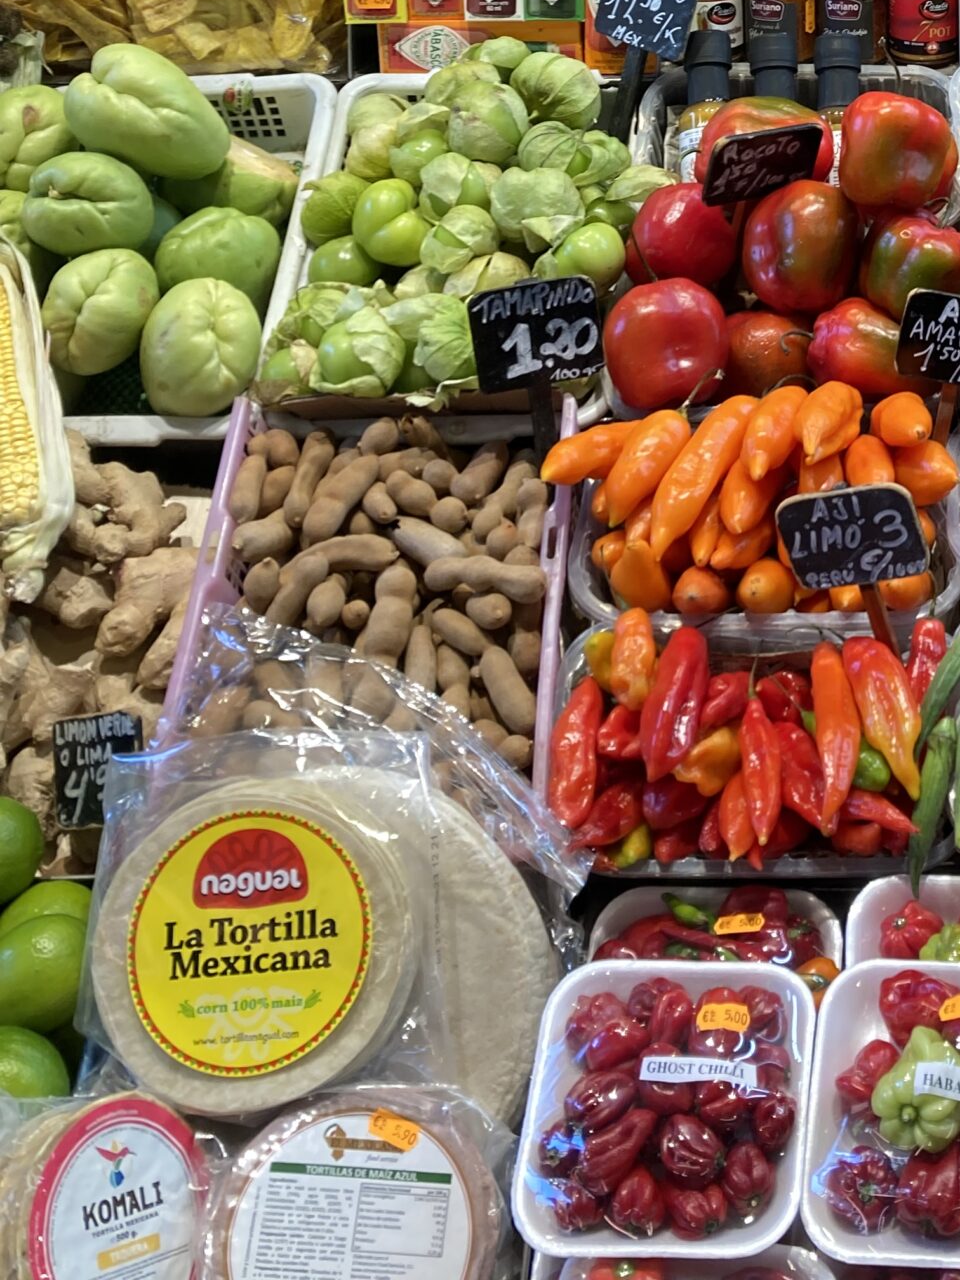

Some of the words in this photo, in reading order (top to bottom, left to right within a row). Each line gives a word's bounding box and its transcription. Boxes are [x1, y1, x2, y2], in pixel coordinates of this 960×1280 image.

[471, 279, 595, 325] TAMARINDO
[810, 493, 861, 524] AJI
[200, 866, 302, 898] nagual
[164, 921, 203, 951] La
[210, 909, 338, 949] Tortilla
[169, 945, 331, 981] Mexicana
[196, 1001, 228, 1015] corn
[232, 997, 270, 1012] 100%
[646, 1059, 694, 1076] GHOST
[697, 1062, 746, 1080] CHILLI
[305, 1165, 354, 1178] TORTILLAS
[367, 1169, 391, 1181] MAÍZ
[393, 1171, 419, 1183] AZUL
[82, 1184, 165, 1231] KOMALI
[91, 1224, 124, 1240] TORTILLA
[124, 1211, 160, 1228] MEXICANA
